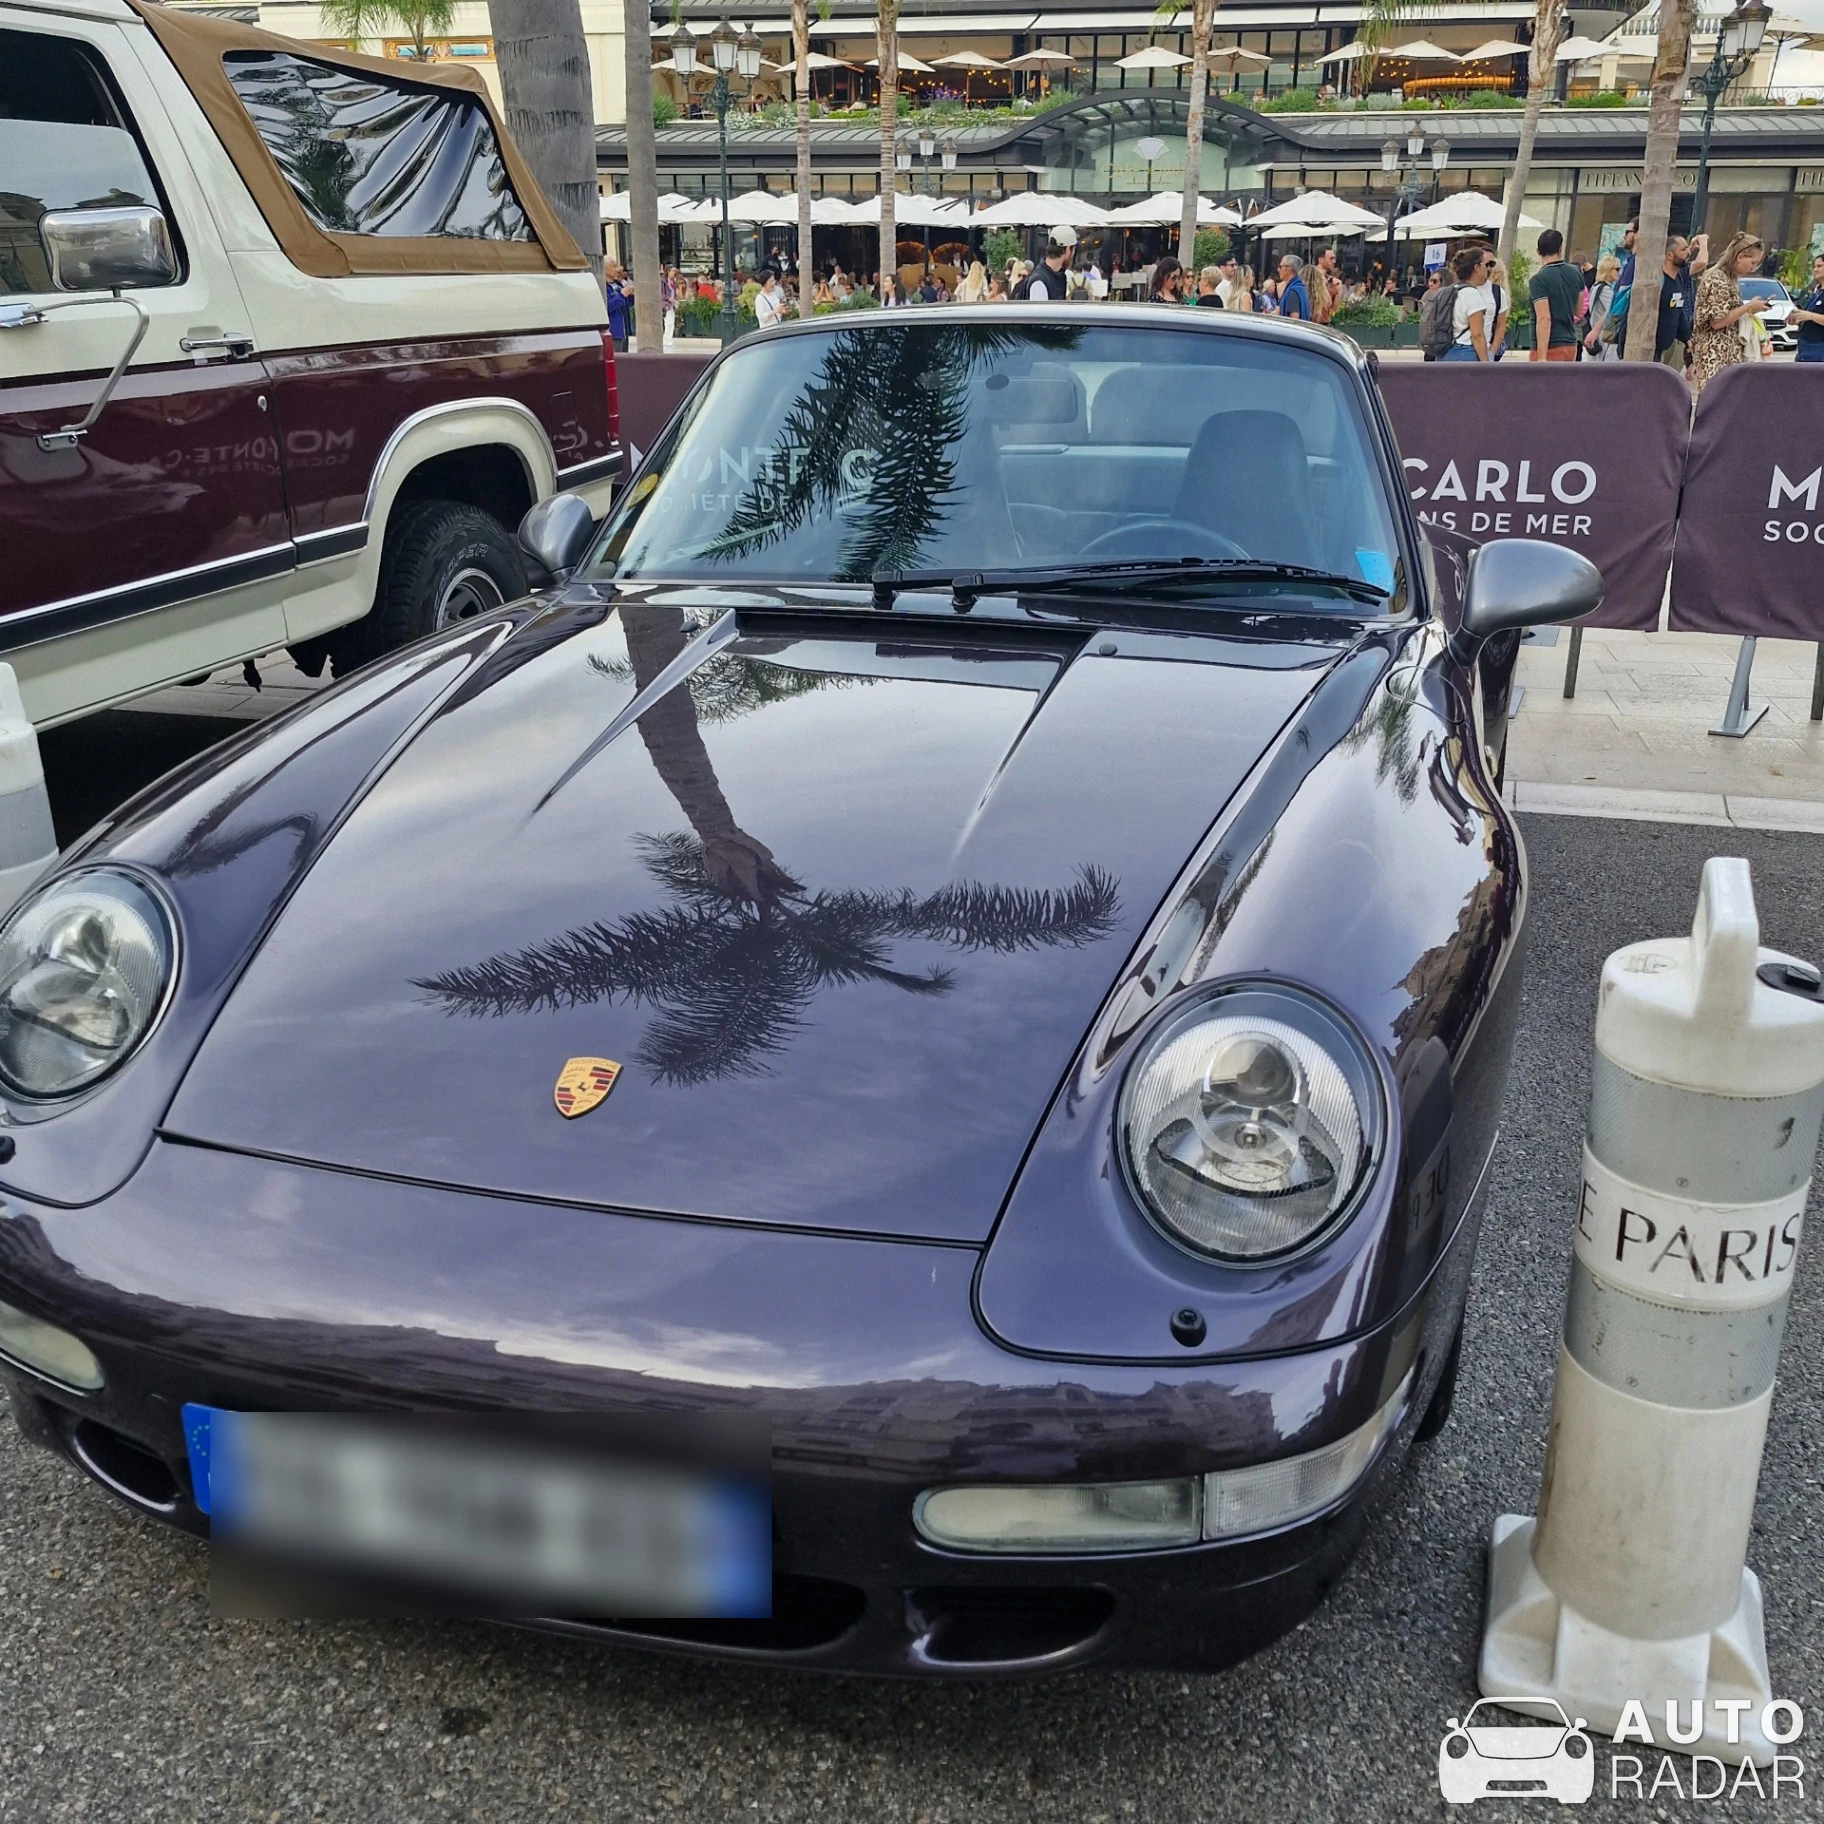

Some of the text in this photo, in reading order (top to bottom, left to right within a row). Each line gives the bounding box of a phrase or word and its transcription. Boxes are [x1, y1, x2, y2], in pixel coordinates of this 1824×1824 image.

[1584, 172, 1643, 187] TIFFAN
[1403, 458, 1597, 504] CARLO
[1471, 512, 1511, 533] DE
[1526, 513, 1592, 536] MER
[1615, 1206, 1800, 1285] PARIS
